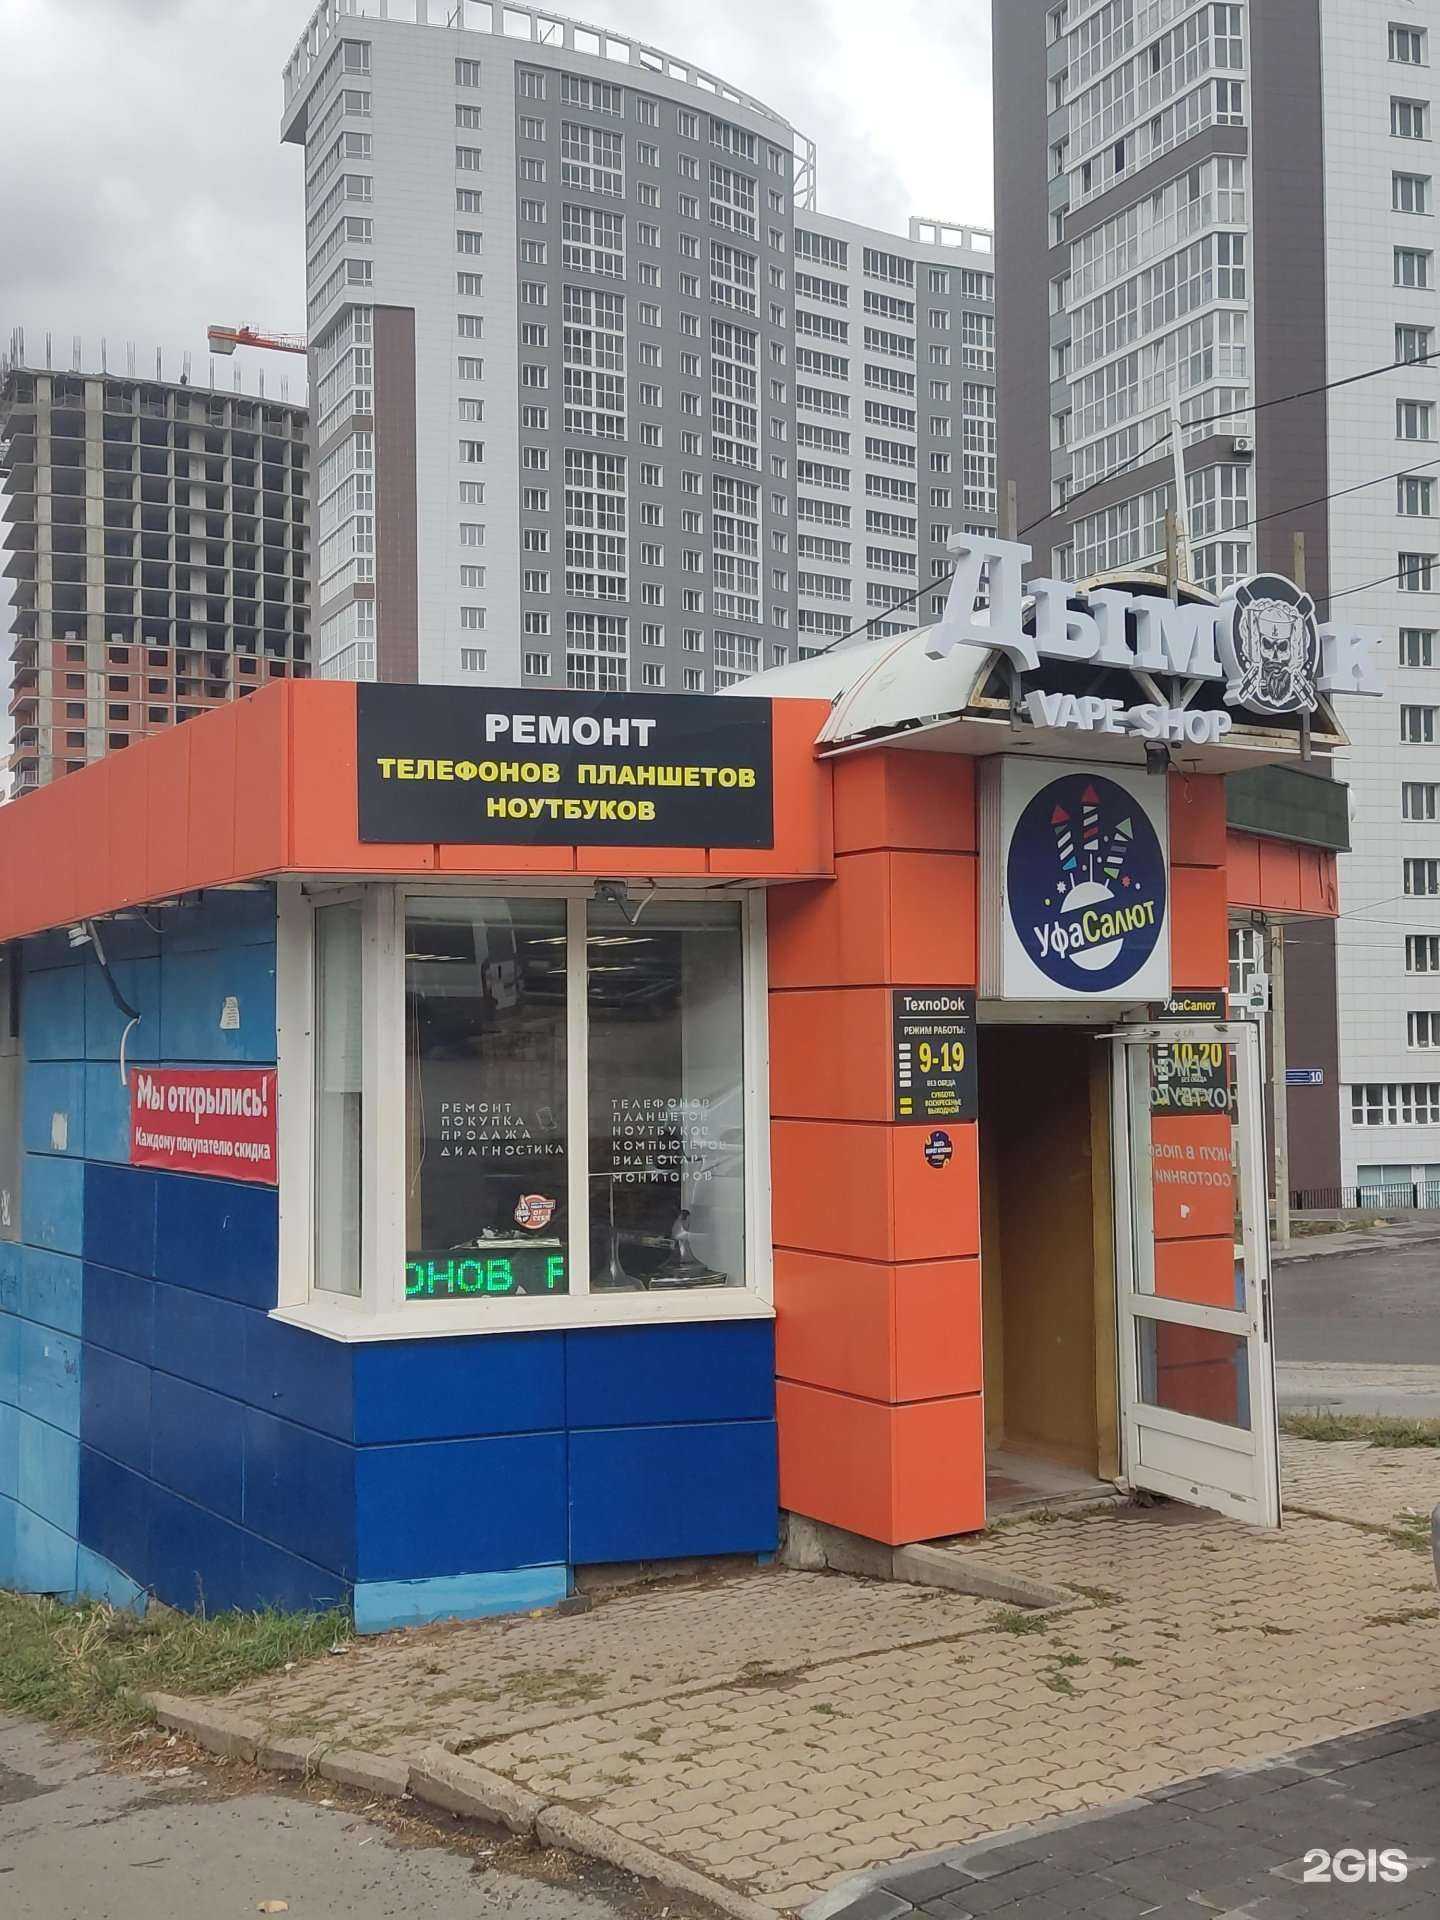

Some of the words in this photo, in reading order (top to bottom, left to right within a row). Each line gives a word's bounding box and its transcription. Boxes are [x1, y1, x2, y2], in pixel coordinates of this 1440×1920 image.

[1025, 690, 1126, 734] VAPE
[1129, 703, 1233, 744] SHOP
[485, 713, 656, 747] РЕМОНТ
[377, 758, 560, 784] ТЕЛЕФОНОВ
[578, 764, 756, 788] ПЛАНШЕТОВ
[487, 797, 656, 821] НОУТБУКОВ
[1034, 900, 1155, 959] УфаСалют
[904, 997, 965, 1011] TexnoDok
[904, 1026, 932, 1036] РЕЖИМ
[919, 1042, 965, 1073] 9-19
[1310, 1071, 1322, 1082] 10
[137, 1074, 165, 1111] Мы
[168, 1076, 268, 1124] открылись!
[441, 1102, 511, 1114] РЕМОНТ
[441, 1115, 524, 1127] ПОКУПКА
[135, 1126, 175, 1156] Каждому
[176, 1135, 233, 1158] покупателю
[234, 1142, 271, 1162] скидка
[441, 1129, 531, 1141] ПРОДАЖА
[441, 1144, 564, 1156] ДИАГНОСТИКА
[612, 1171, 712, 1183] МОНИТОРОВ
